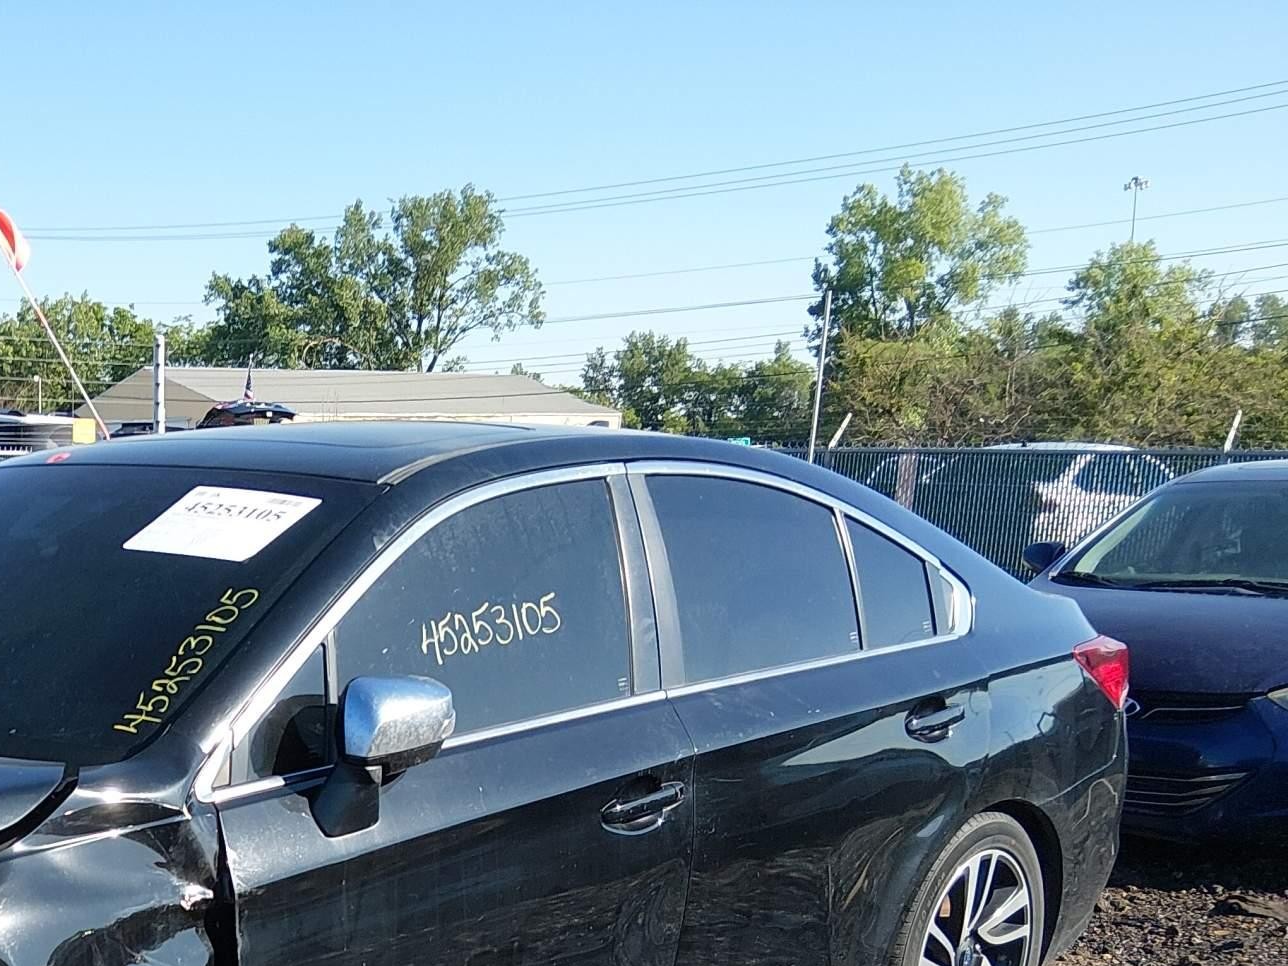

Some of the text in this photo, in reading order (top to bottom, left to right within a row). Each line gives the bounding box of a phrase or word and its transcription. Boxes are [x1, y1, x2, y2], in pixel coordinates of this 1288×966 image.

[185, 501, 288, 522] 45253105
[113, 588, 259, 733] 45253105
[421, 592, 561, 665] 45253105
